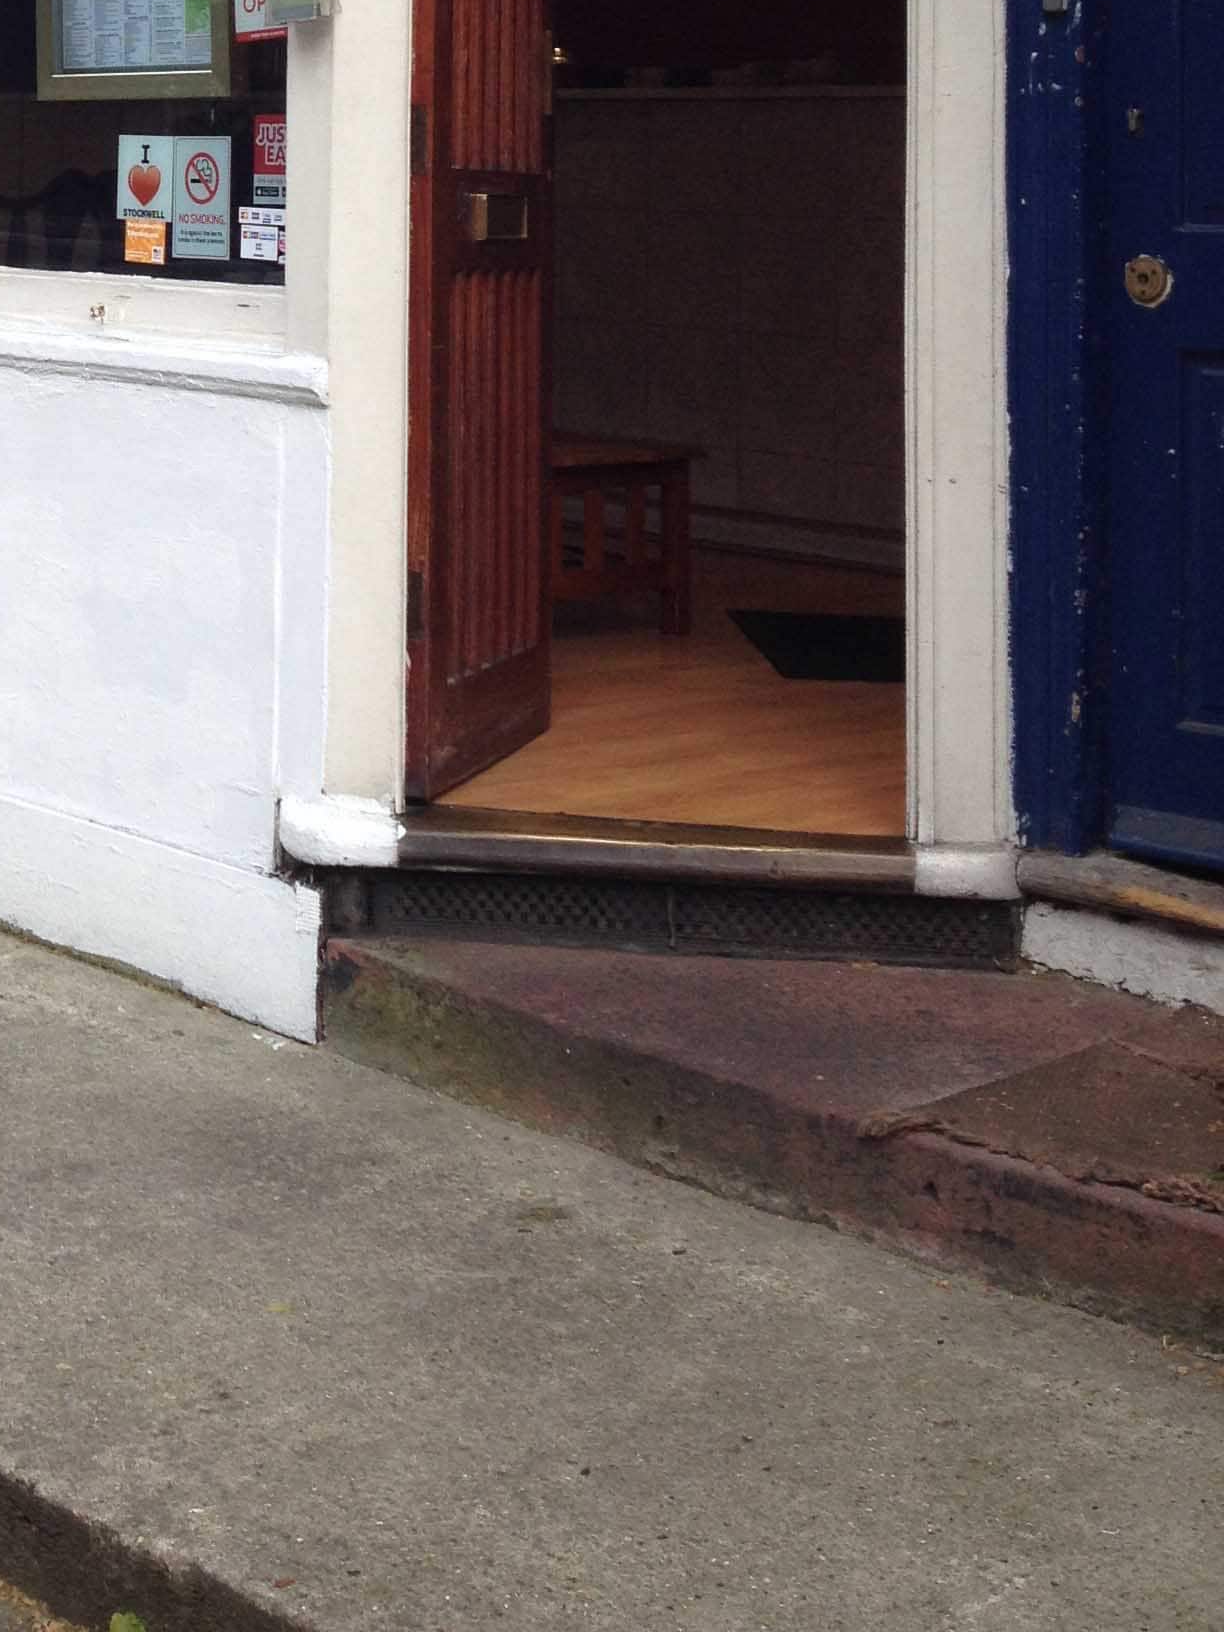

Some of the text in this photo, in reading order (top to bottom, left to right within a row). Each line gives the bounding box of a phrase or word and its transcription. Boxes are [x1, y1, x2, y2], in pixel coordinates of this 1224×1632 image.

[256, 123, 286, 145] JUS
[264, 144, 286, 165] EA
[122, 208, 165, 219] STOCKWELL
